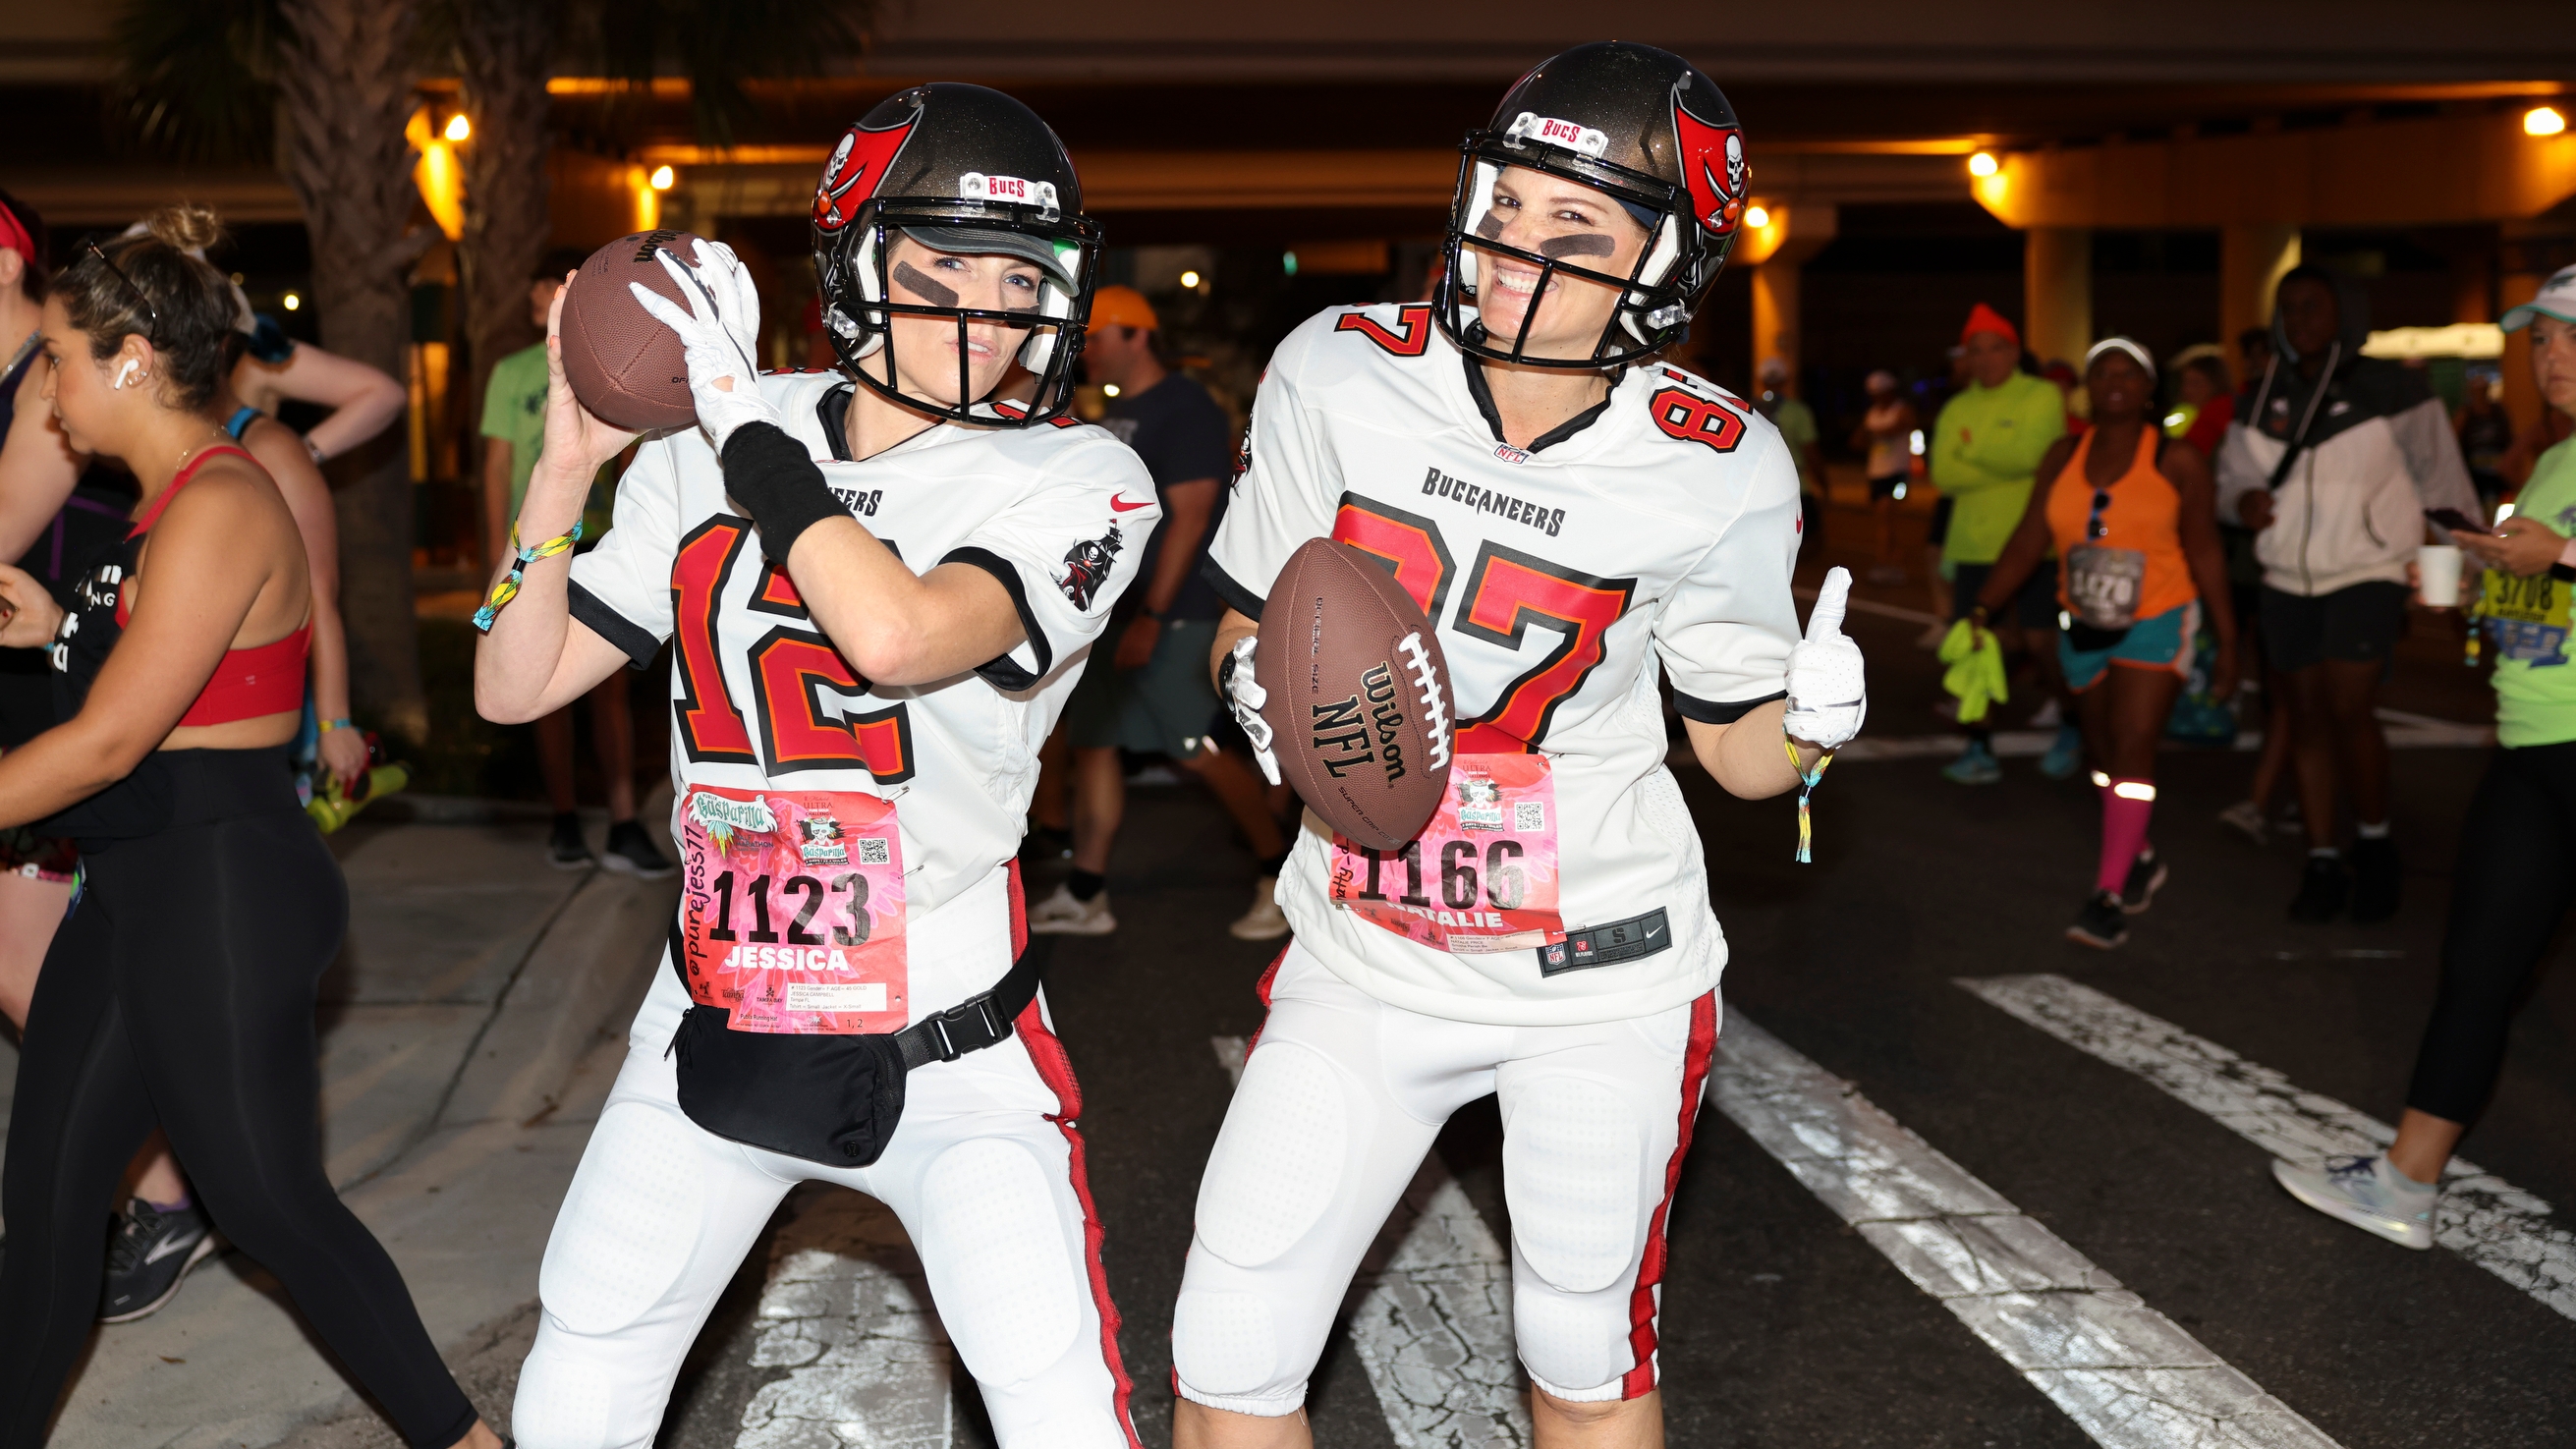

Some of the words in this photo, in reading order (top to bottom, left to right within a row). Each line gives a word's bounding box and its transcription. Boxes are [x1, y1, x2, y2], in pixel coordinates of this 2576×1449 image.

[1541, 119, 1581, 143] BUCS
[988, 177, 1025, 197] BUCS
[1497, 447, 1521, 463] NFL
[829, 487, 883, 517] EERS
[1421, 467, 1566, 537] BUCCANEERS
[1361, 661, 1407, 783] Wilson
[1313, 695, 1375, 779] NFL
[1338, 786, 1364, 815] SUPER
[1358, 840, 1524, 911] 1166
[709, 871, 871, 946] 1123
[1612, 927, 1626, 943] S
[724, 945, 850, 972] JESSICA
[1549, 952, 1564, 962] NFL
[857, 1019, 863, 1028] 2
